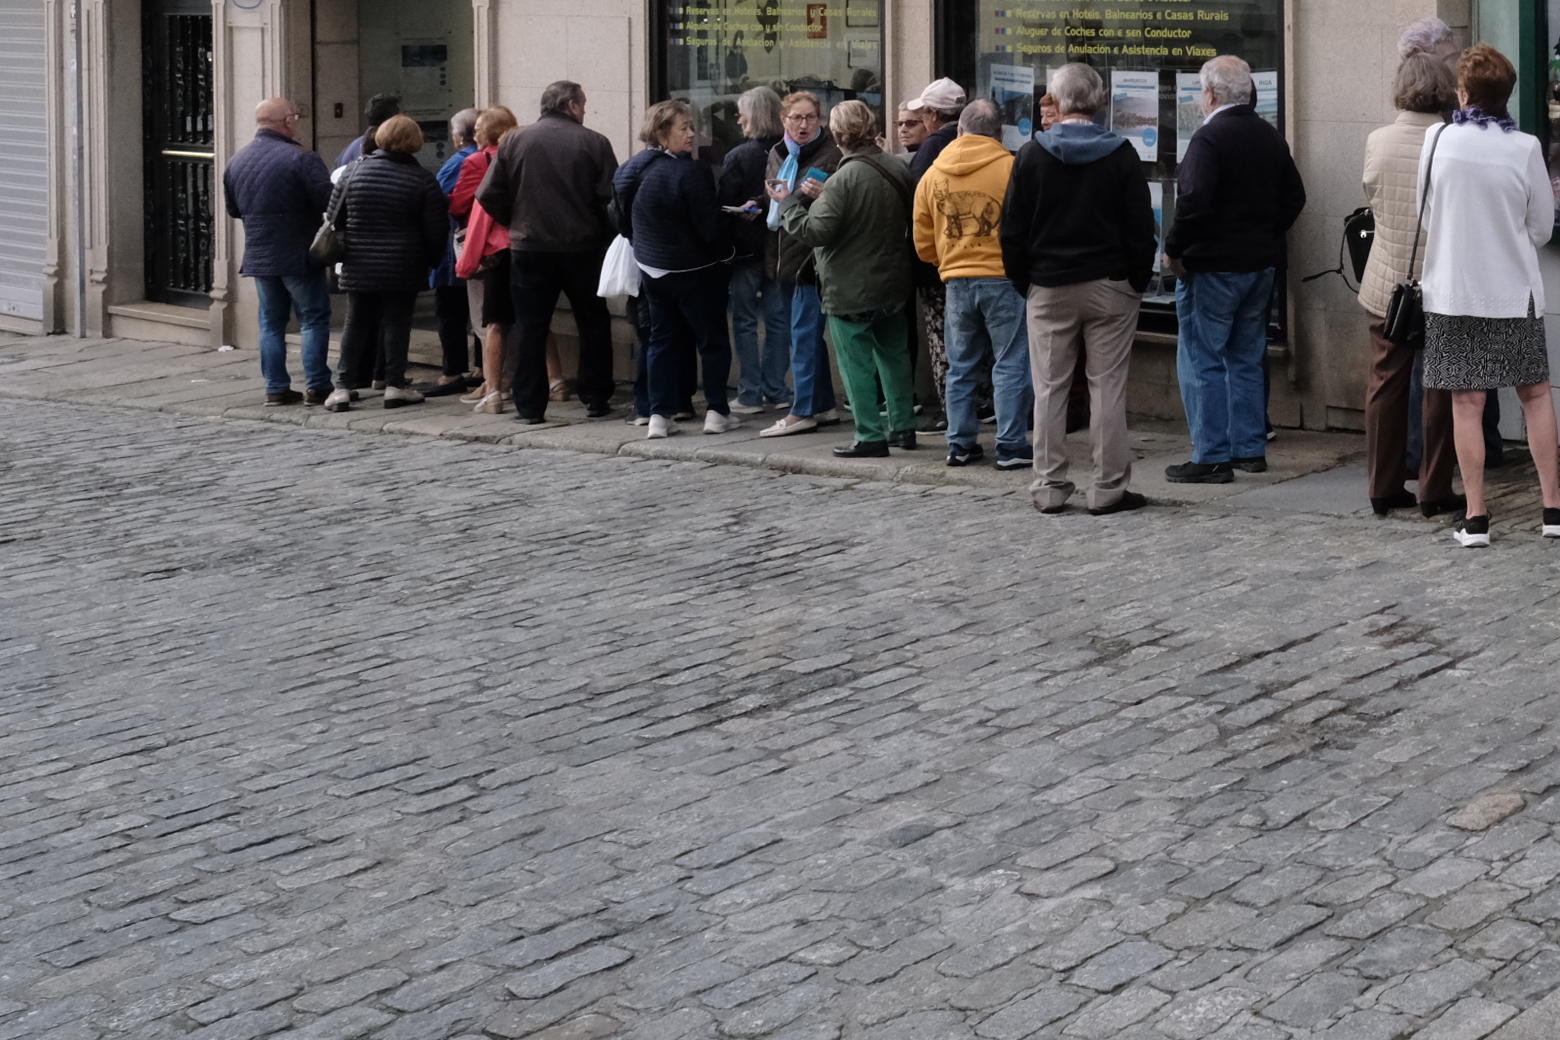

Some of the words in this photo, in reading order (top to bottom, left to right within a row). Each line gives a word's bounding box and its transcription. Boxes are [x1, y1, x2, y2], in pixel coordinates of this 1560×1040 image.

[1059, 10, 1069, 19] en
[1104, 9, 1153, 20] Balnearios
[1164, 9, 1194, 20] Casas
[1197, 9, 1229, 21] Rurais
[1051, 26, 1062, 36] de
[1064, 26, 1096, 37] Coches
[1098, 28, 1115, 37] con
[1126, 29, 1142, 38] sen
[1144, 27, 1192, 38] Conductor
[1054, 43, 1065, 53] de
[1121, 45, 1169, 56] Asistencia
[1171, 47, 1183, 55] en
[1185, 45, 1217, 57] Viaxes
